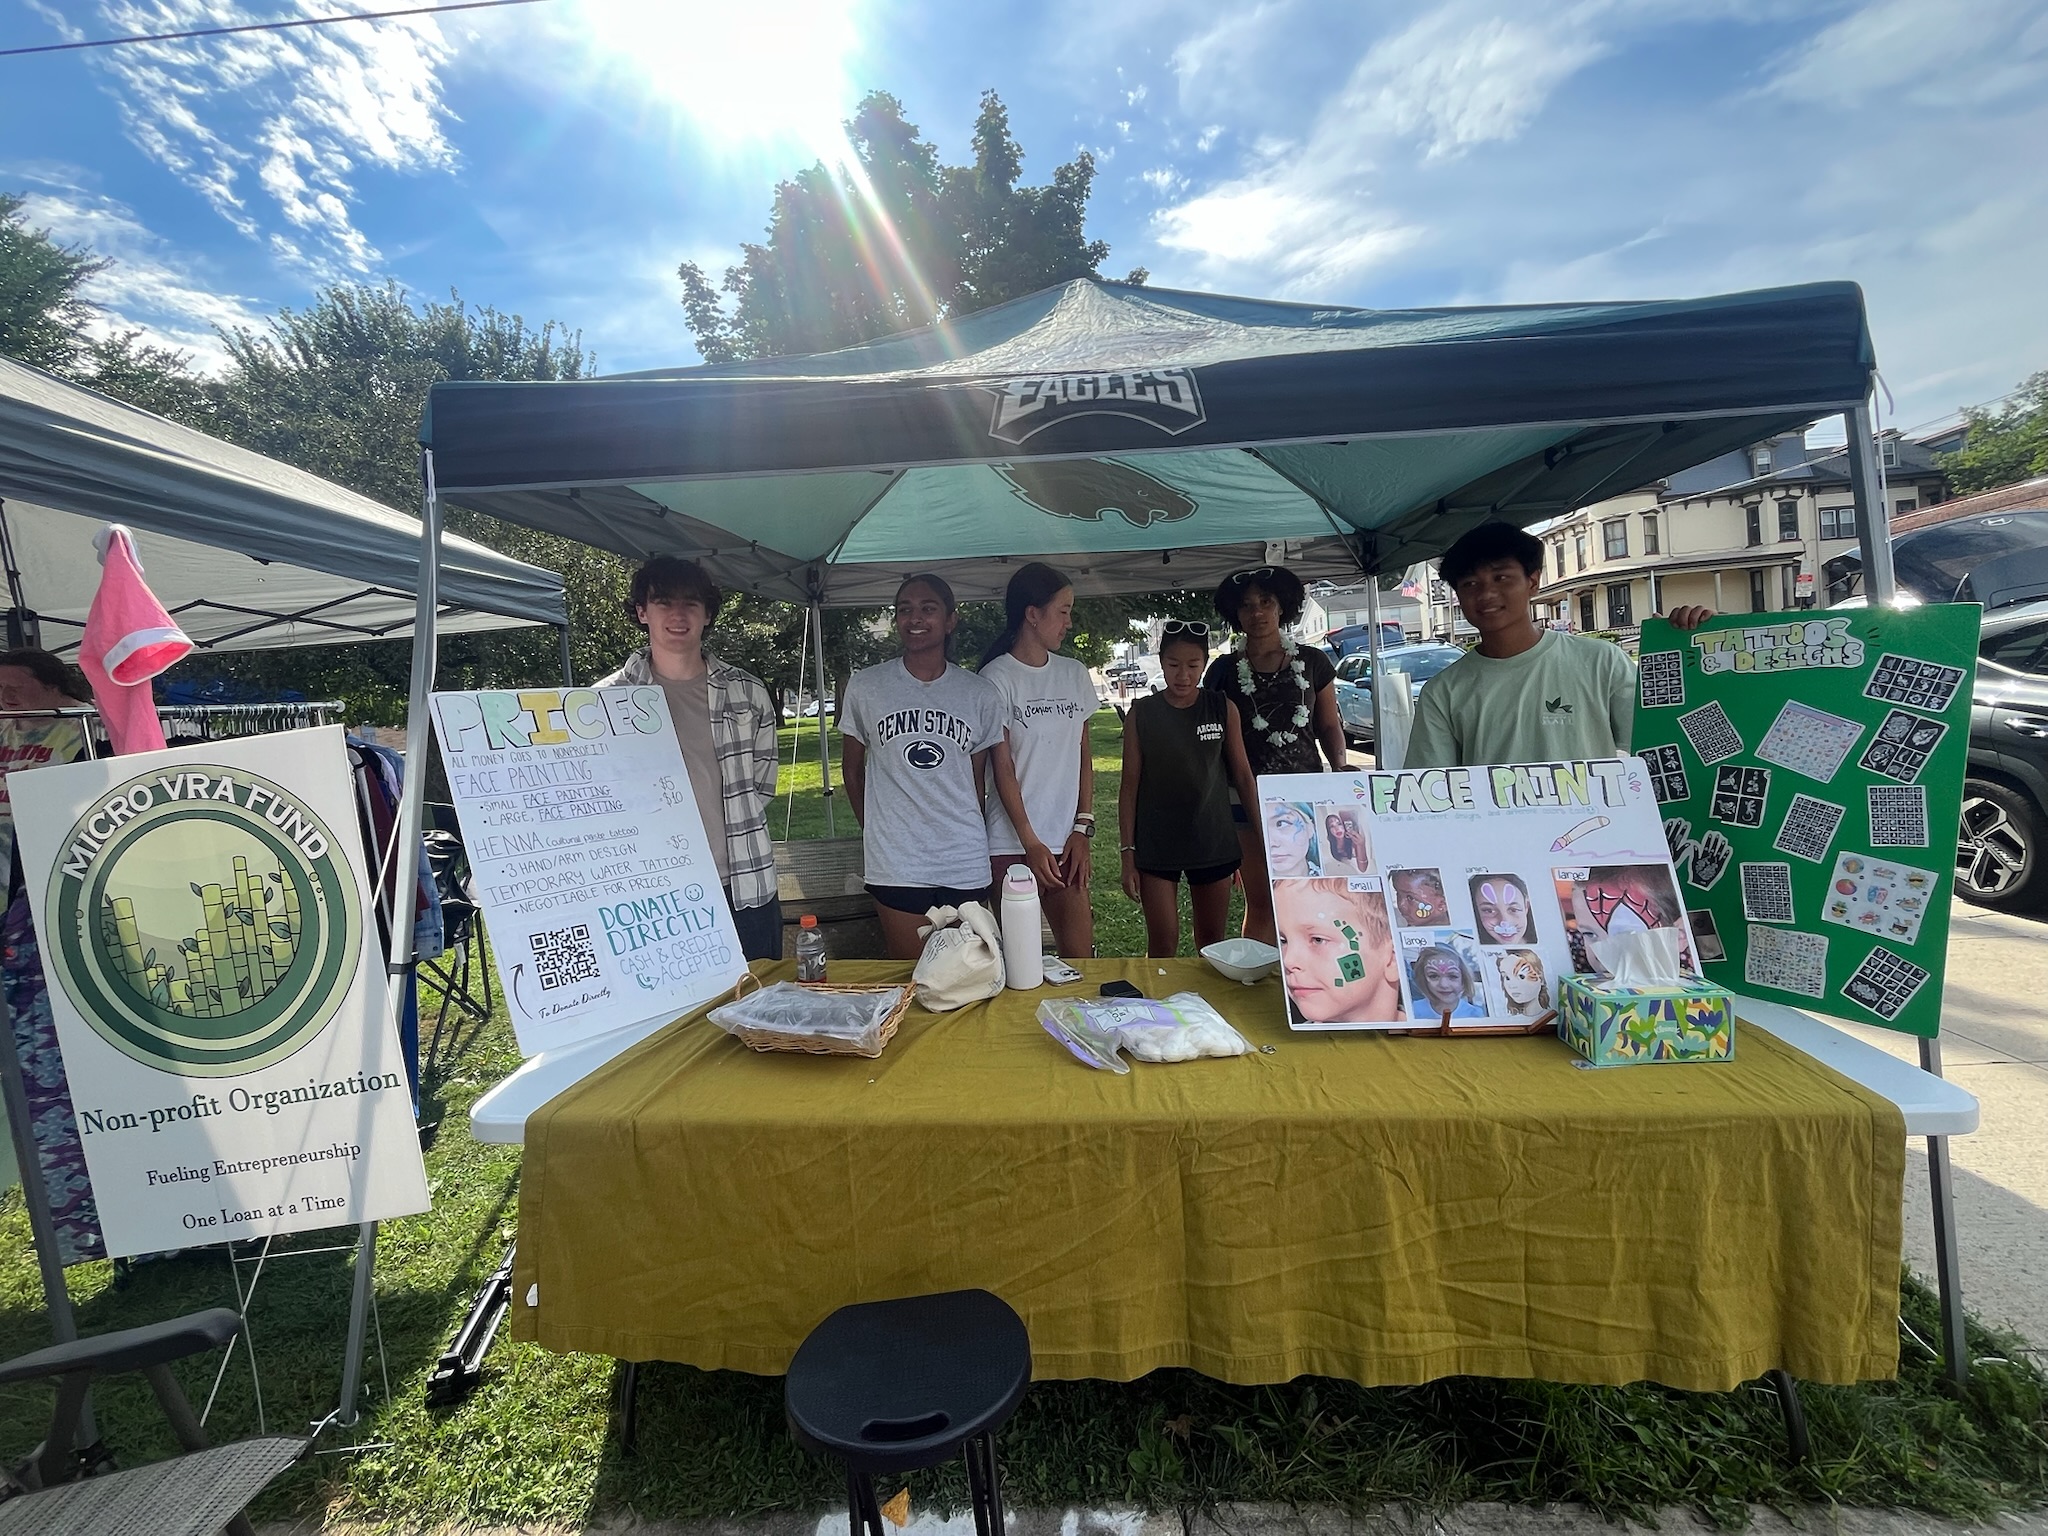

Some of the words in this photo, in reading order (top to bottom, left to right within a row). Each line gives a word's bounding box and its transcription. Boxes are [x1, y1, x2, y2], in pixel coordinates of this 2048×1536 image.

[997, 367, 1200, 430] EAGLES
[1693, 619, 1848, 655] TATTOOS
[1702, 655, 1721, 672] &
[1734, 641, 1863, 672] DESIGNS
[435, 687, 664, 752] PRICES
[876, 709, 921, 747] PENN
[923, 707, 973, 753] STATE
[1196, 722, 1224, 735] ARCOLA
[1200, 733, 1221, 741] MUSIC
[451, 756, 468, 769] ALL
[472, 754, 504, 767] MONEY
[510, 751, 533, 763] GOES
[536, 749, 548, 760] TO
[455, 769, 501, 796] FACE
[507, 758, 593, 790] PAINTING
[484, 800, 518, 813] SMALL
[522, 792, 550, 809] FACE
[555, 785, 612, 802] PAINTING
[1368, 768, 1476, 815] FACE
[1487, 759, 1627, 808] PAINT
[61, 783, 155, 883] MICRO
[157, 772, 237, 804] VRA
[242, 782, 330, 862] FUND
[538, 806, 565, 821] FACE
[569, 799, 624, 817] PAINTING
[473, 831, 546, 860] HENNA
[609, 826, 640, 840] tattoo)
[590, 842, 638, 861] DESIGN
[485, 871, 586, 904] TEMPORARY
[590, 860, 633, 881] WATER
[1349, 882, 1374, 891] small
[1557, 869, 1586, 881] large
[519, 888, 600, 915] NEGOTIABLE
[603, 881, 627, 896] FOR
[628, 874, 672, 892] PRICES
[598, 888, 687, 931] DONATE
[606, 905, 717, 956] DIRECTLY
[1403, 935, 1428, 946] large
[619, 951, 655, 976] CASH
[656, 947, 670, 964] &
[671, 929, 726, 959] CREDIT
[660, 946, 732, 986] ACCEPTED
[538, 1007, 551, 1020] To
[552, 999, 580, 1016] Donate
[581, 986, 612, 1005] Directly
[81, 1094, 222, 1137] Non-profit
[228, 1070, 401, 1117] Organization
[146, 1163, 211, 1187] Fueling
[213, 1140, 362, 1178] Entrepreneurship
[182, 1212, 218, 1231] One
[222, 1204, 264, 1225] Loan
[267, 1203, 285, 1220] at
[288, 1202, 299, 1215] a
[301, 1193, 346, 1213] Time
